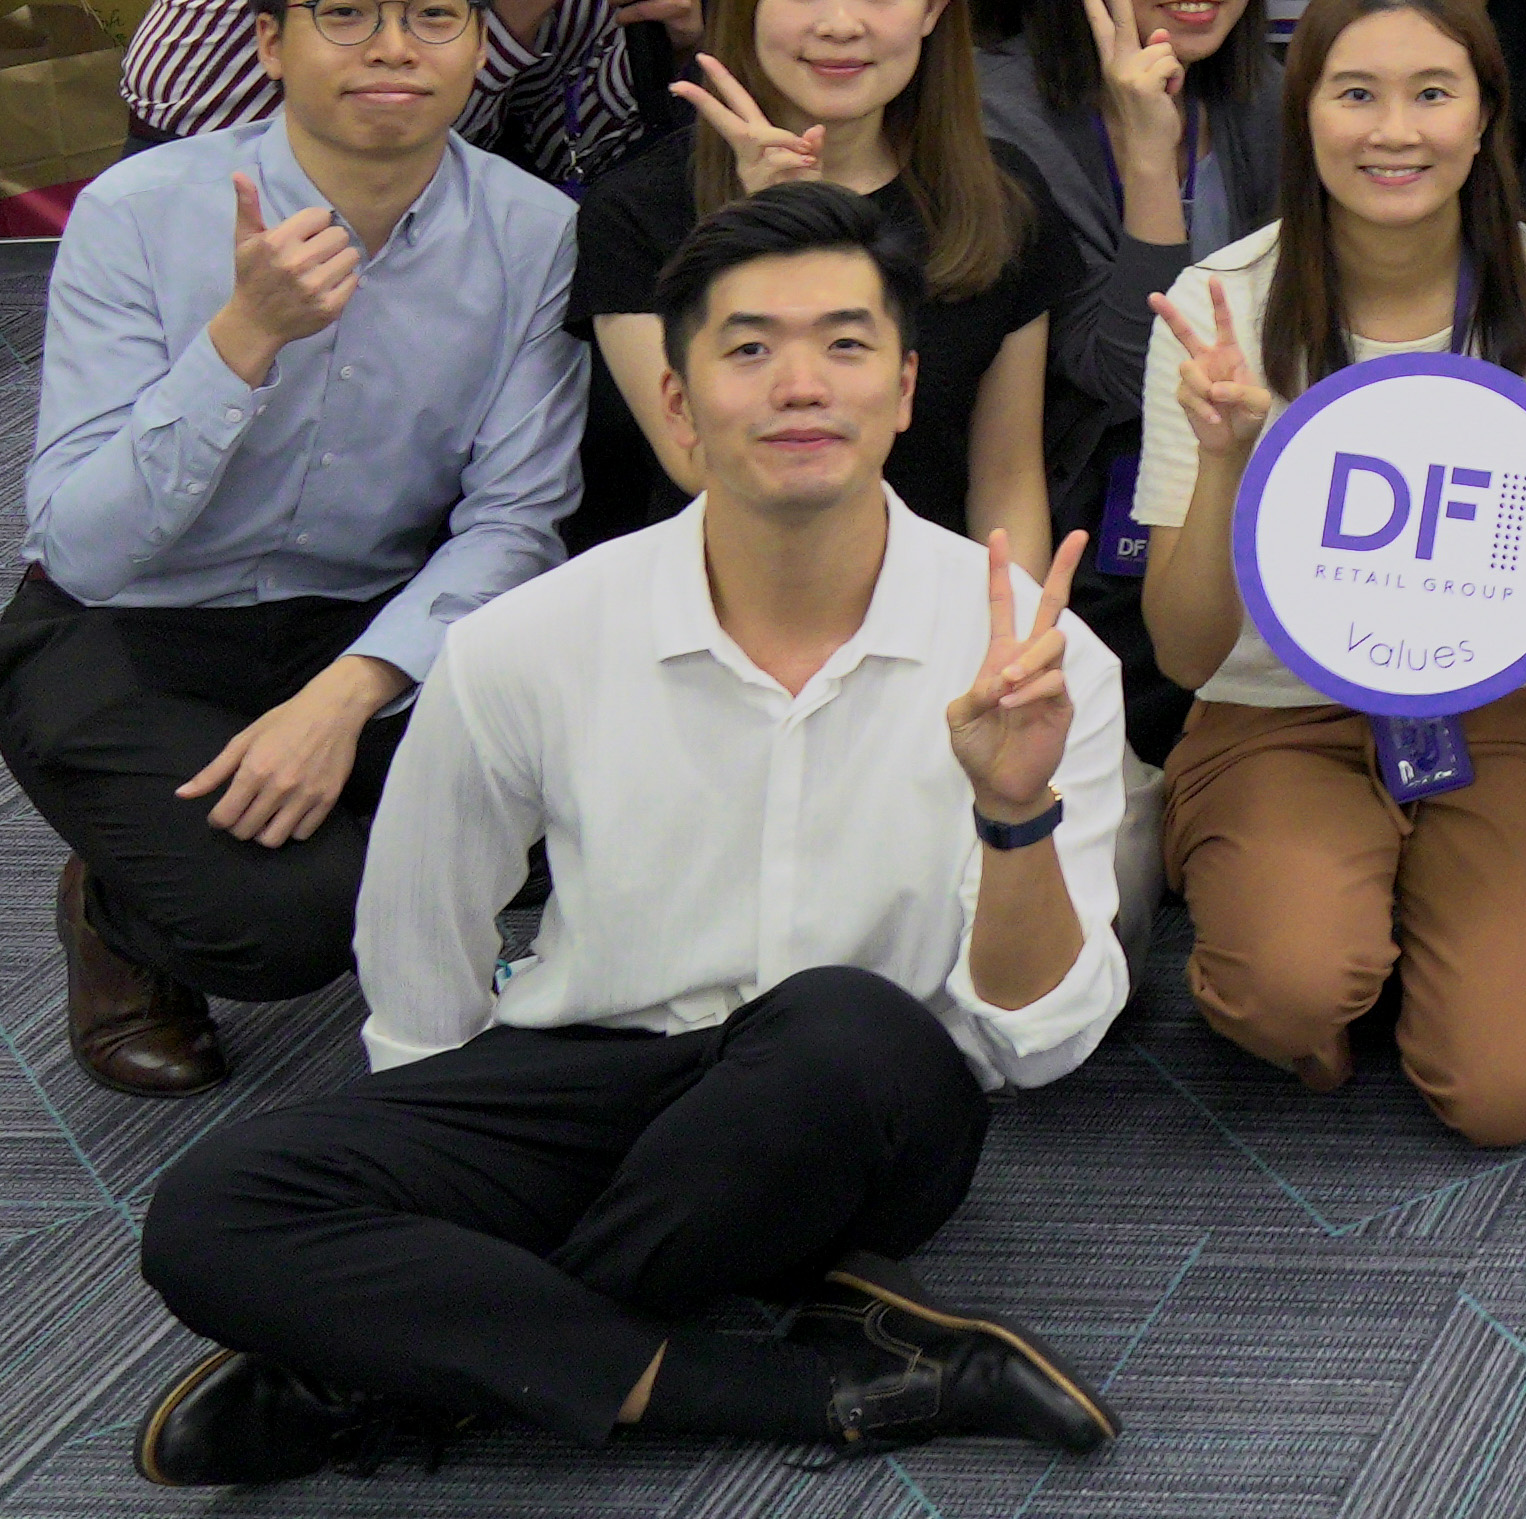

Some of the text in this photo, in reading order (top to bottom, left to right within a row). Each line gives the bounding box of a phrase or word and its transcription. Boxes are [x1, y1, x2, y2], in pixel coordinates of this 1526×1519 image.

[1316, 563, 1515, 601] RETAIL GROUP
[1346, 620, 1475, 671] Values
